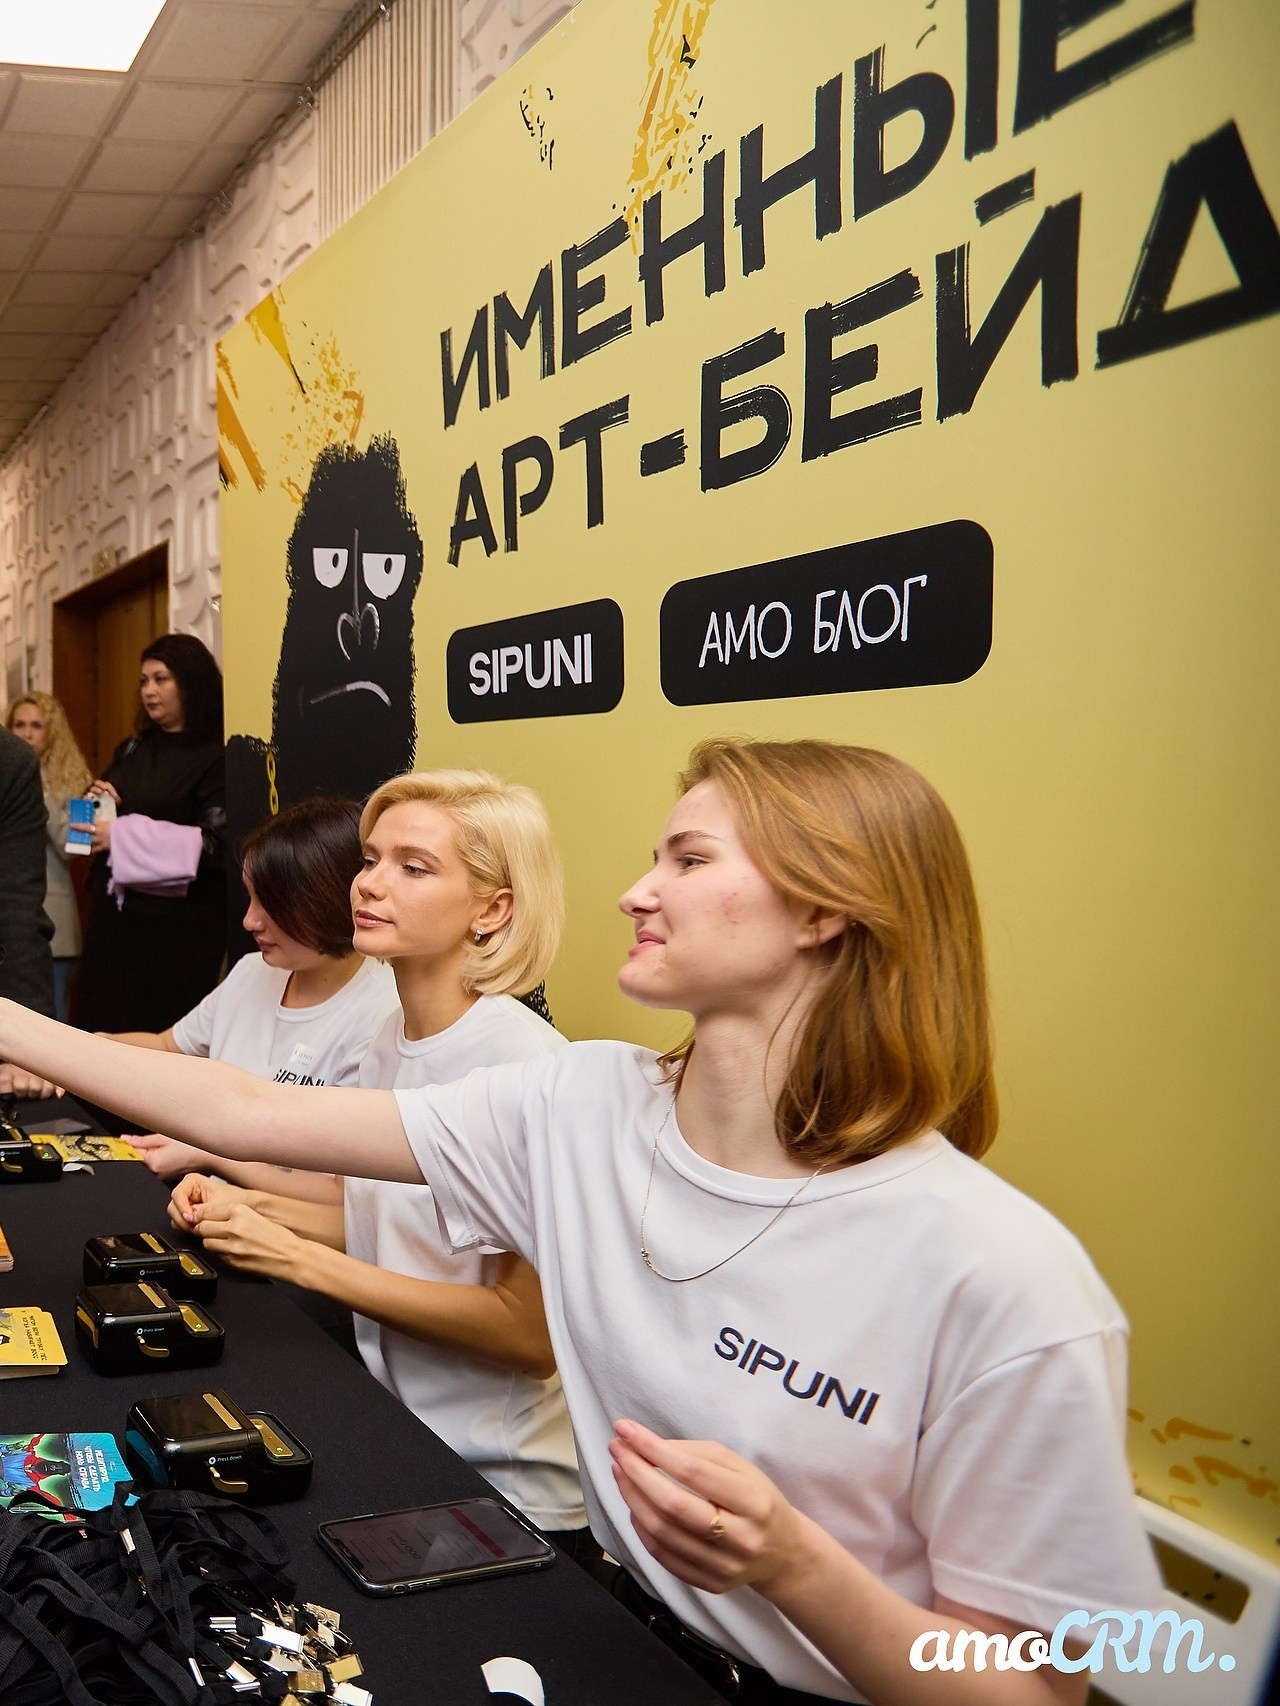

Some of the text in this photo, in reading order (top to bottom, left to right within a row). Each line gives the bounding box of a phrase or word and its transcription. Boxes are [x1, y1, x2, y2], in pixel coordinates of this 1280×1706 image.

[697, 574, 927, 670] АМО БЛОГ
[467, 633, 593, 698] SIPUNI
[714, 1325, 881, 1426] SIPUNI
[75, 1450, 90, 1489] НОЛЬ СПРАВА
[84, 1445, 101, 1492] ЧТОБЫ СДЕЛАТЬ
